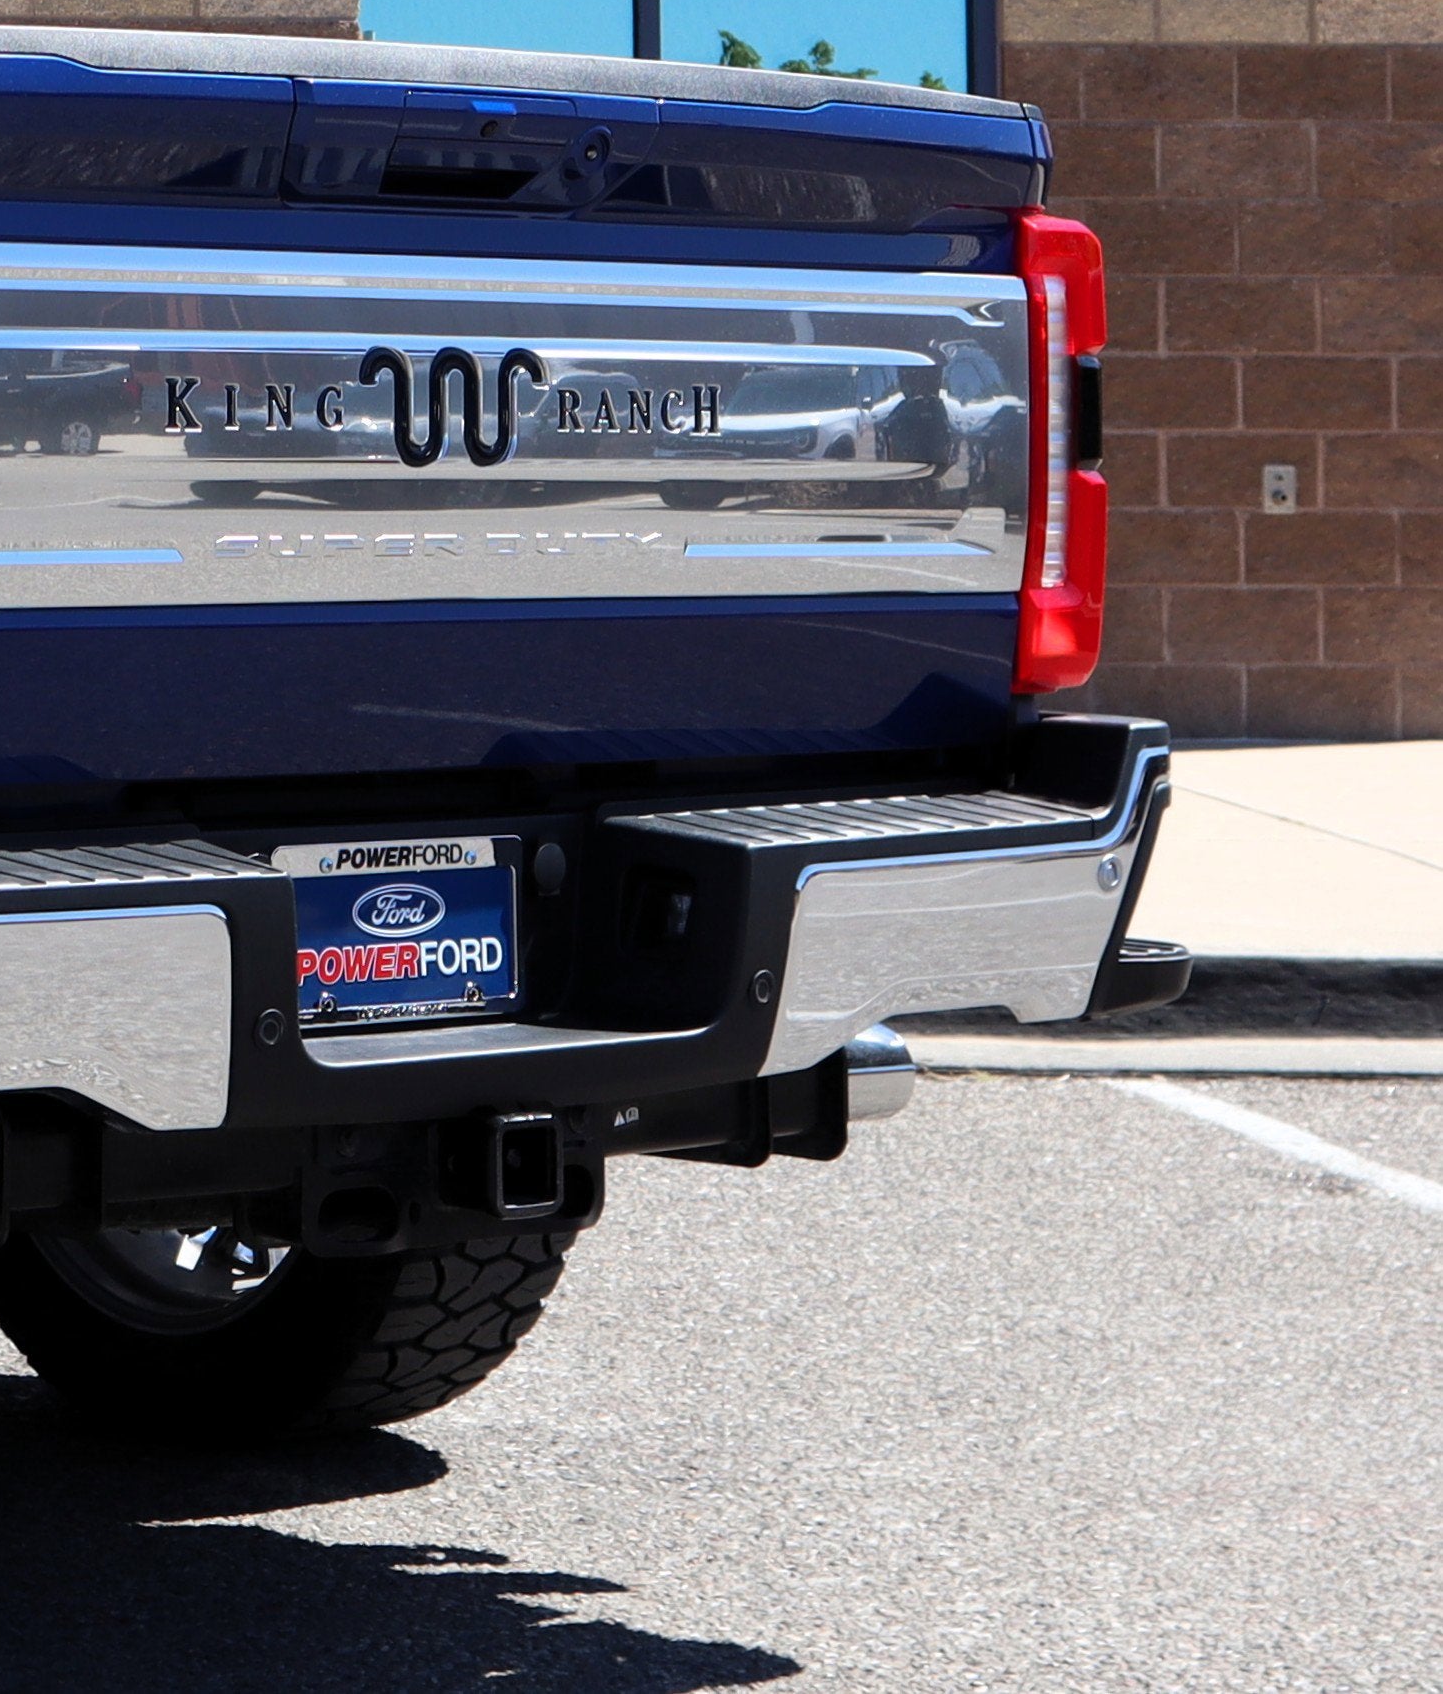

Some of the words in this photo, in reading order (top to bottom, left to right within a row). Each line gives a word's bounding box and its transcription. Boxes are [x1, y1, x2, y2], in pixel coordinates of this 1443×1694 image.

[165, 376, 345, 434] KING
[556, 383, 723, 437] RANCH
[214, 532, 465, 558] SUPER
[335, 843, 463, 870] POWERFORD
[370, 893, 426, 926] Ford
[296, 936, 503, 987] POWERFORD
